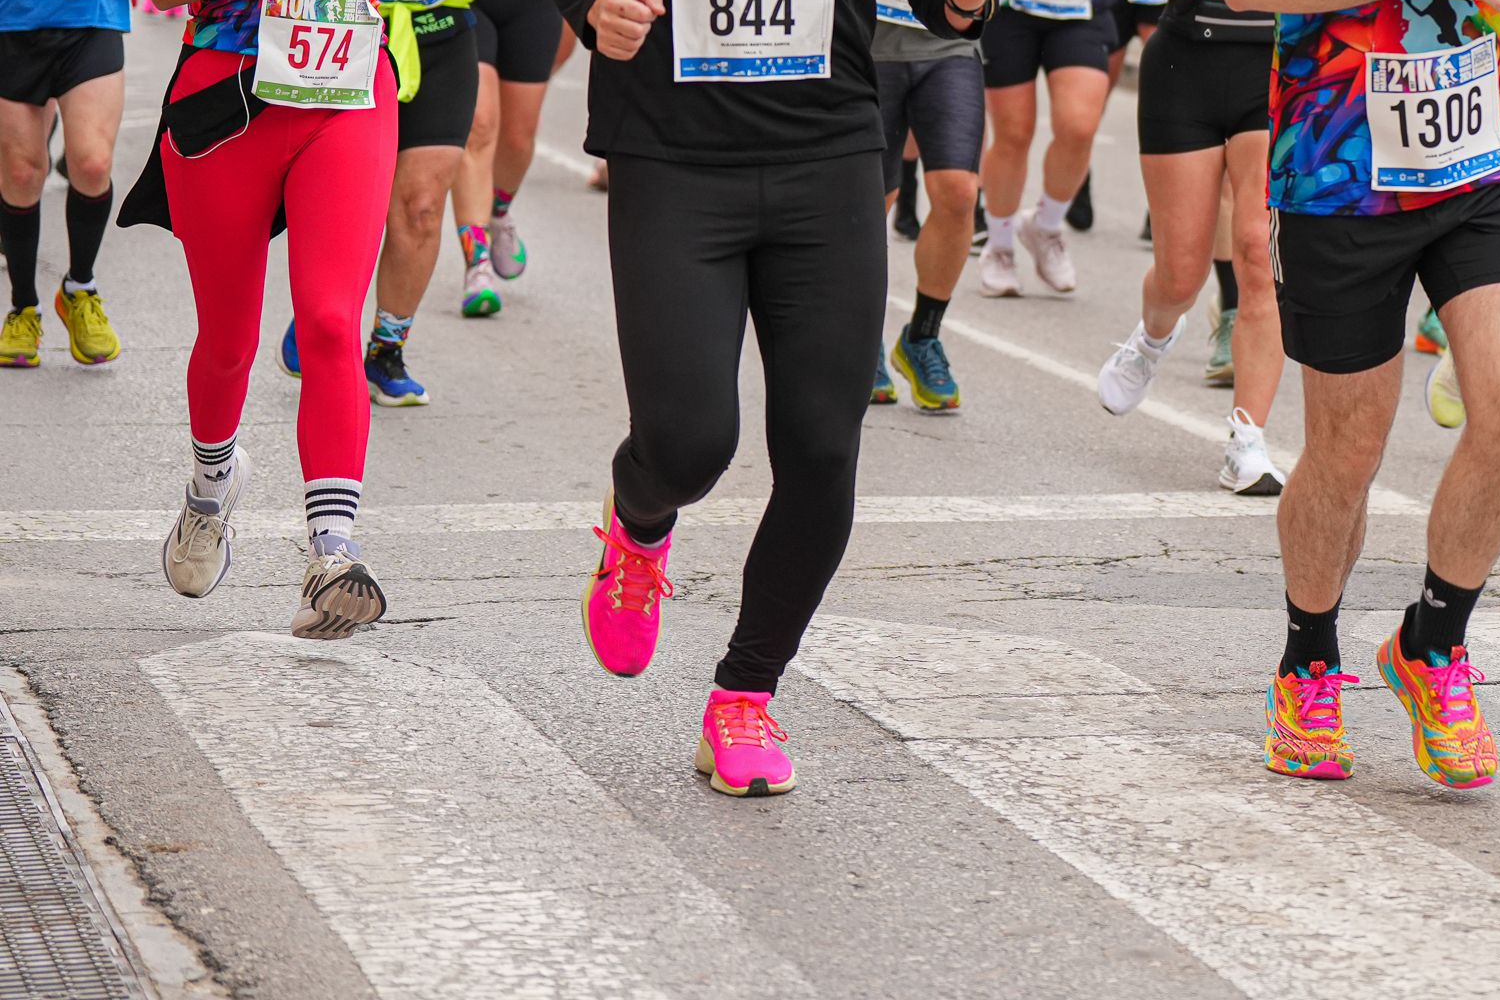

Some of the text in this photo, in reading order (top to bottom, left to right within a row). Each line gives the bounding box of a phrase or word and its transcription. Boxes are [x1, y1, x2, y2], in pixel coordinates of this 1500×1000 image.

[288, 25, 353, 70] 574
[1388, 58, 1436, 92] 21K
[1390, 85, 1482, 148] 1306
